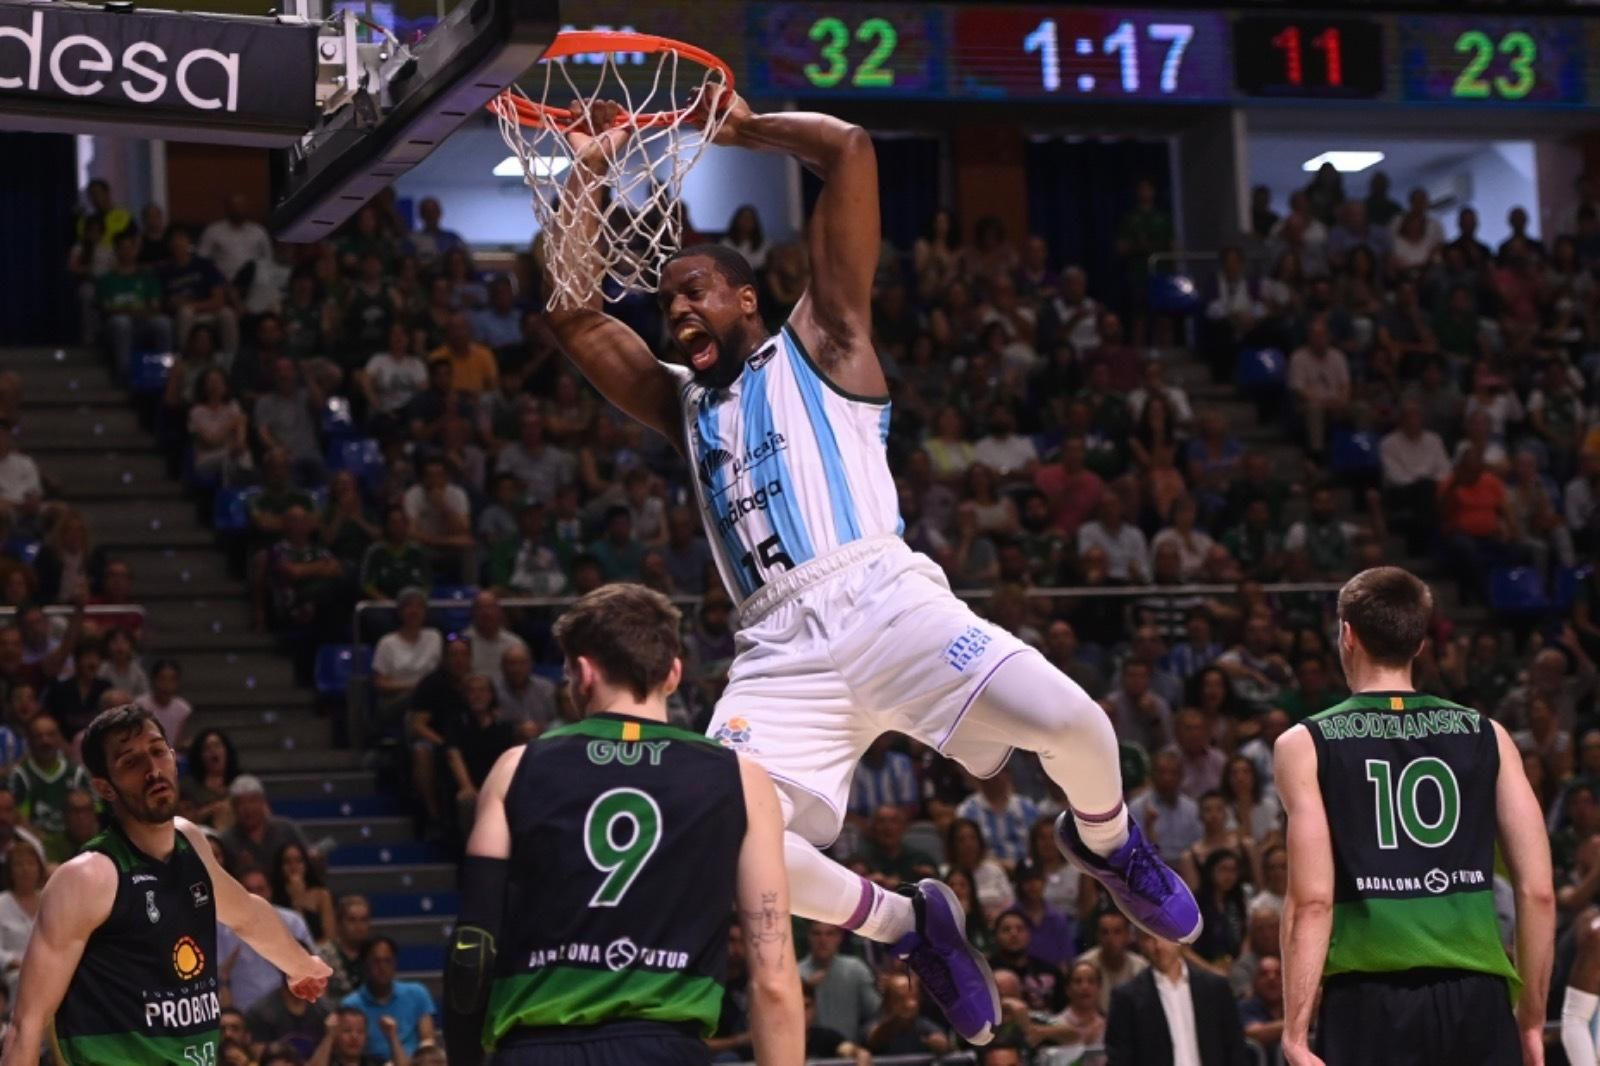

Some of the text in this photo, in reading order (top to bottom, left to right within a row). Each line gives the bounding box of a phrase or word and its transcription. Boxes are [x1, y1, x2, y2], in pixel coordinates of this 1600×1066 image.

[804, 18, 898, 87] 32
[1023, 18, 1194, 92] 1:17
[1272, 26, 1342, 86] 11
[1452, 31, 1537, 98] 23
[741, 533, 796, 589] 15
[586, 740, 671, 766] GUY
[1365, 757, 1460, 849] 10
[584, 787, 663, 907] 9
[1356, 877, 1422, 891] BADALONA
